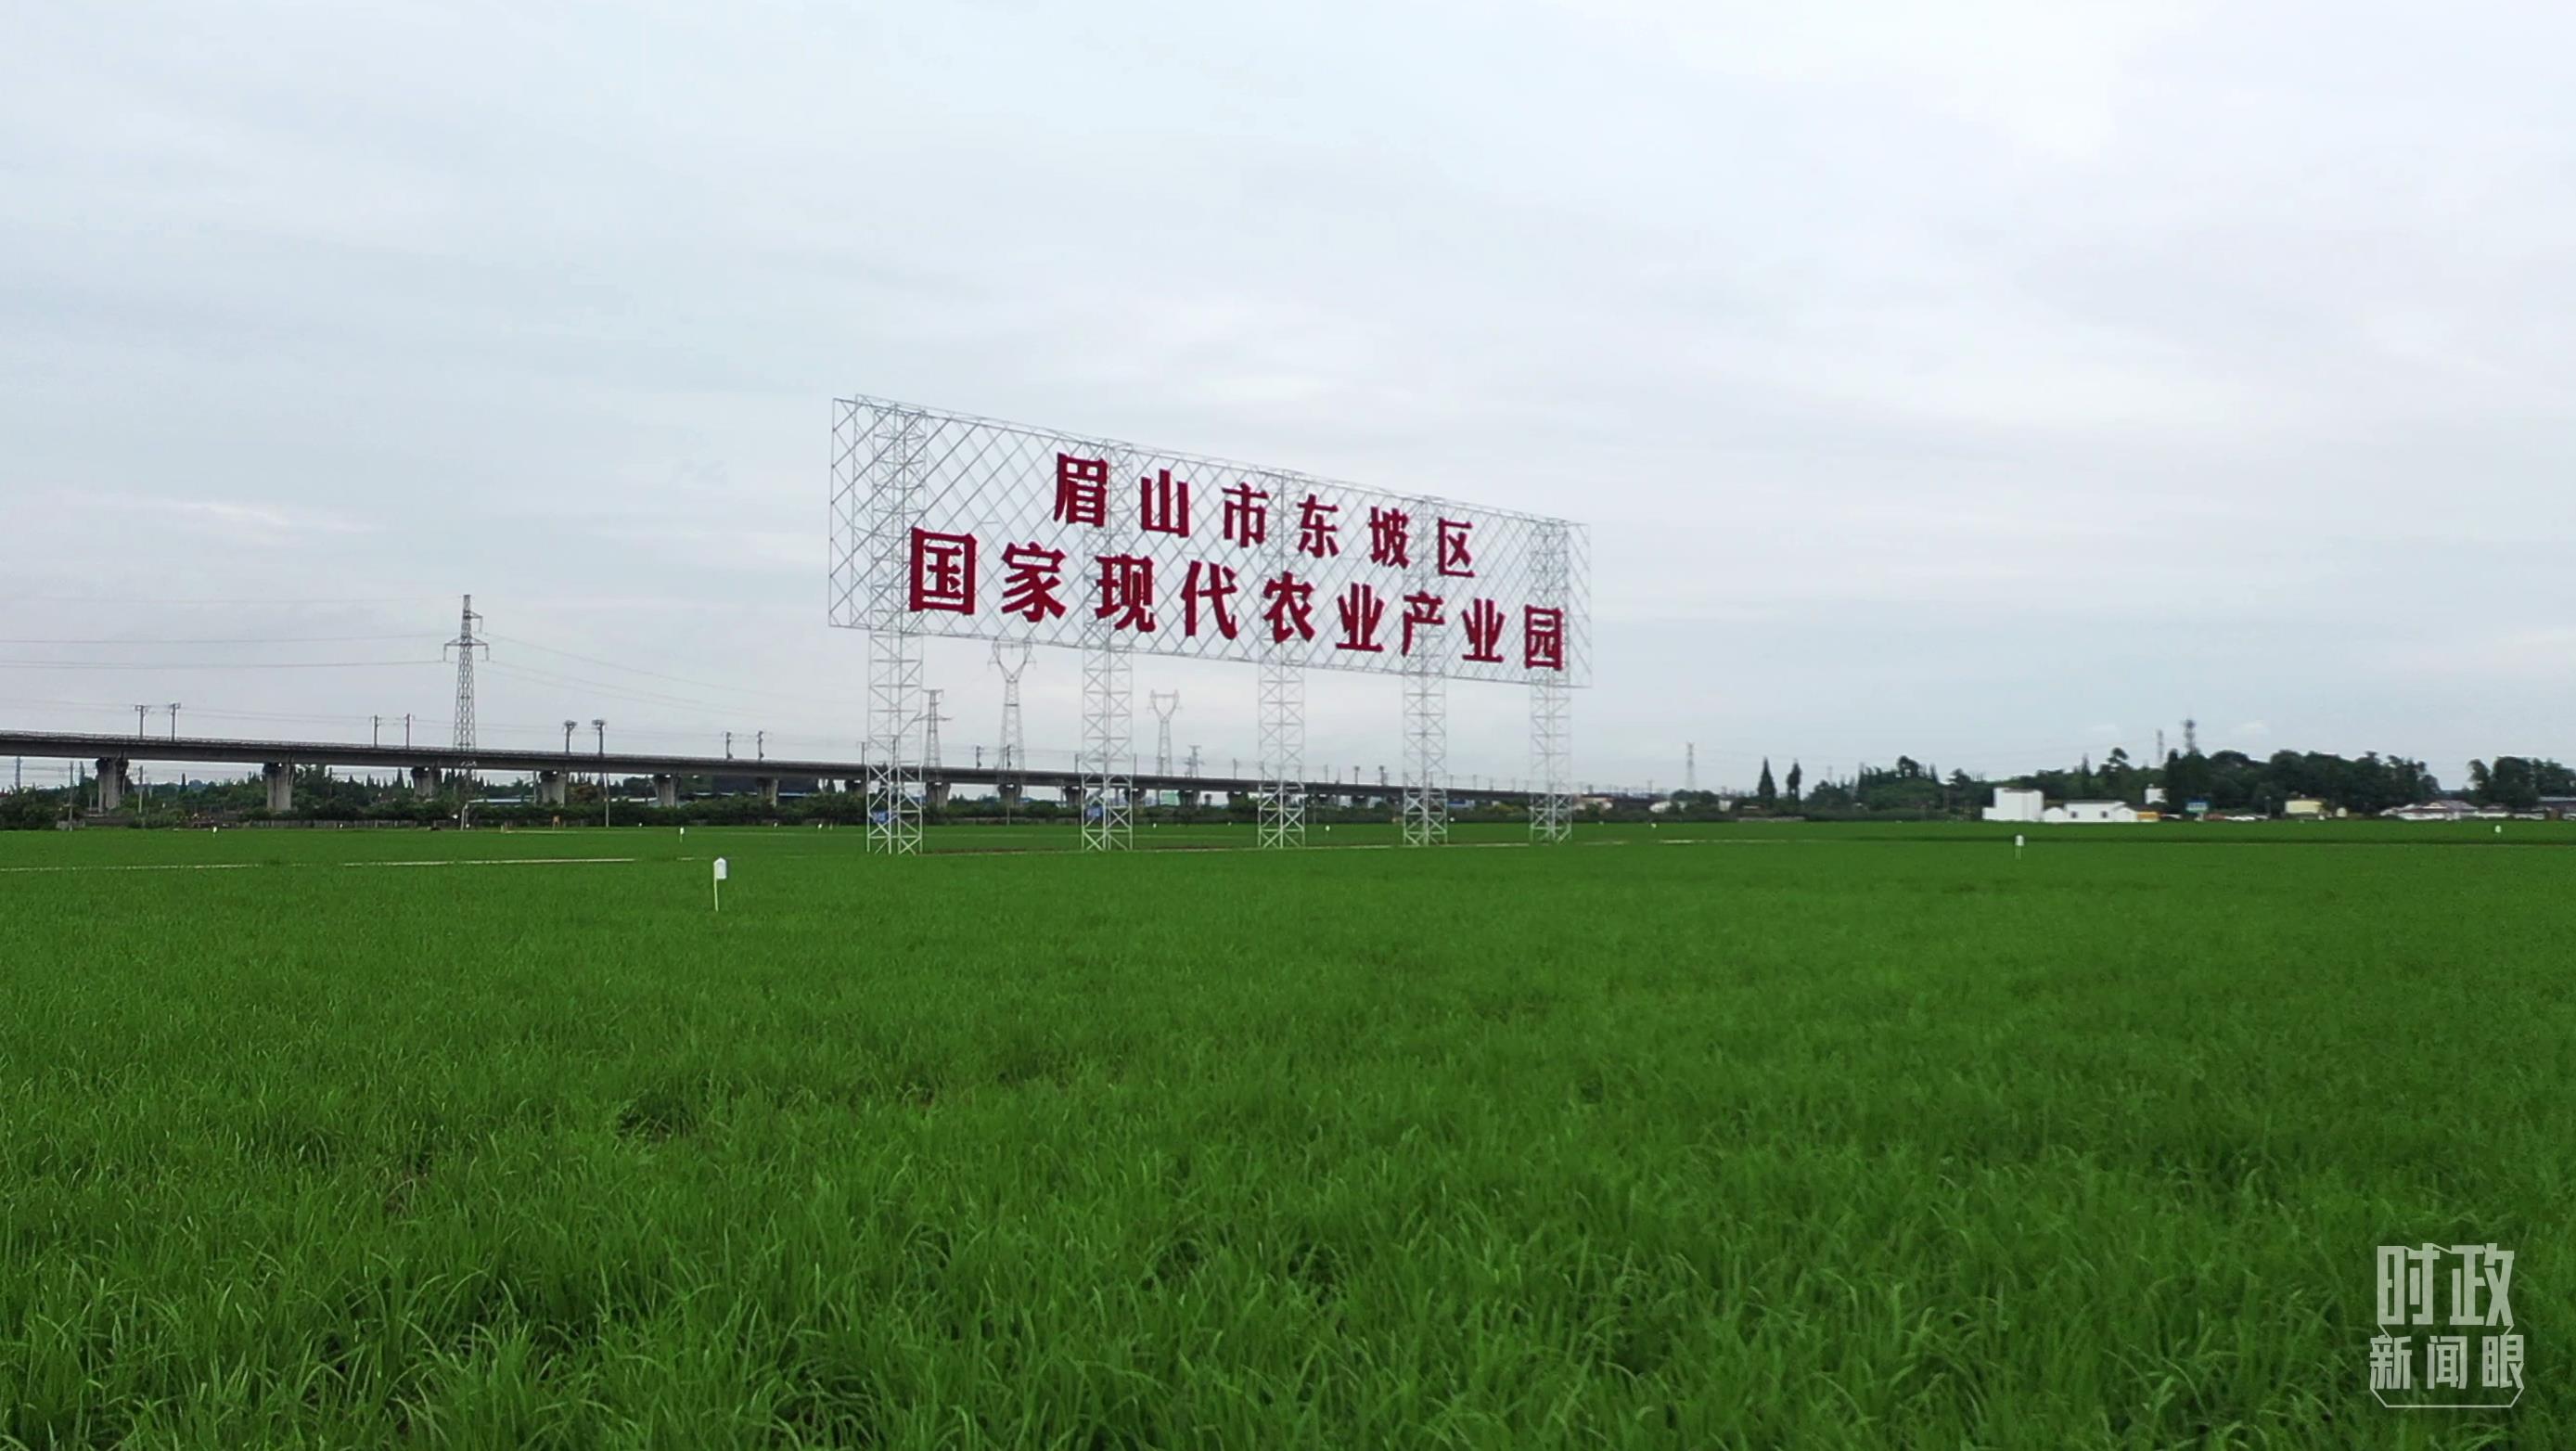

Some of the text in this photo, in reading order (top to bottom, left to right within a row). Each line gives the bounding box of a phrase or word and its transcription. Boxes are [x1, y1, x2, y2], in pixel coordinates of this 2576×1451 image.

[1056, 454, 1475, 576] 眉山市东坡区
[909, 526, 1564, 670] 国家现代农业产业园
